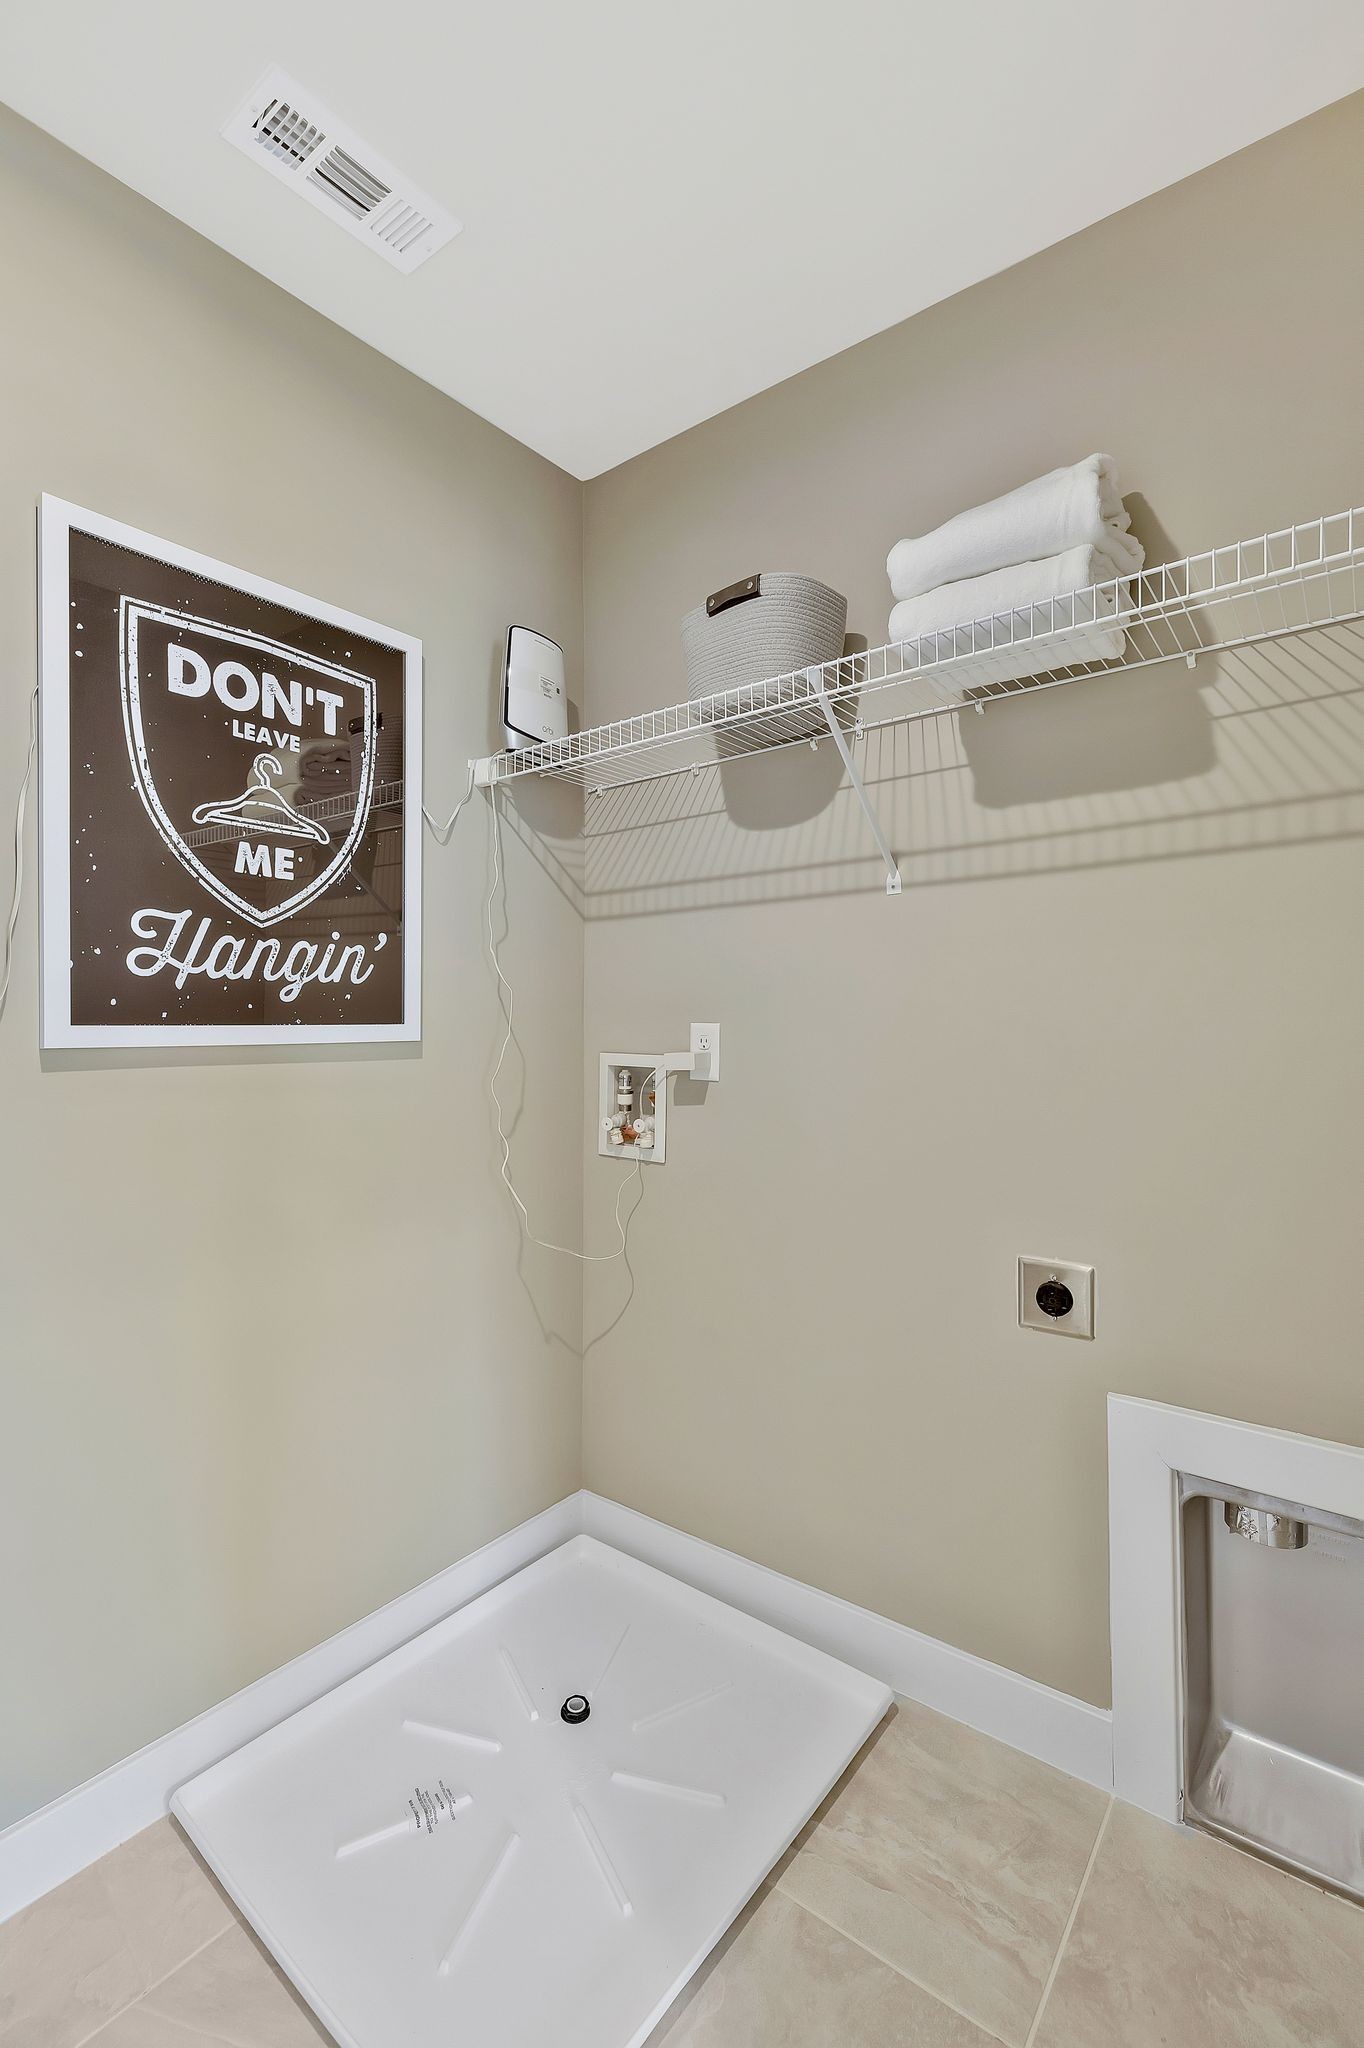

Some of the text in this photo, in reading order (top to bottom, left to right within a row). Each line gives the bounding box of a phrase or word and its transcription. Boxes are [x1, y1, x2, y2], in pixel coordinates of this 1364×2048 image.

[168, 642, 344, 736] DON'T
[232, 719, 300, 753] LEAVE
[234, 841, 295, 881] ME
